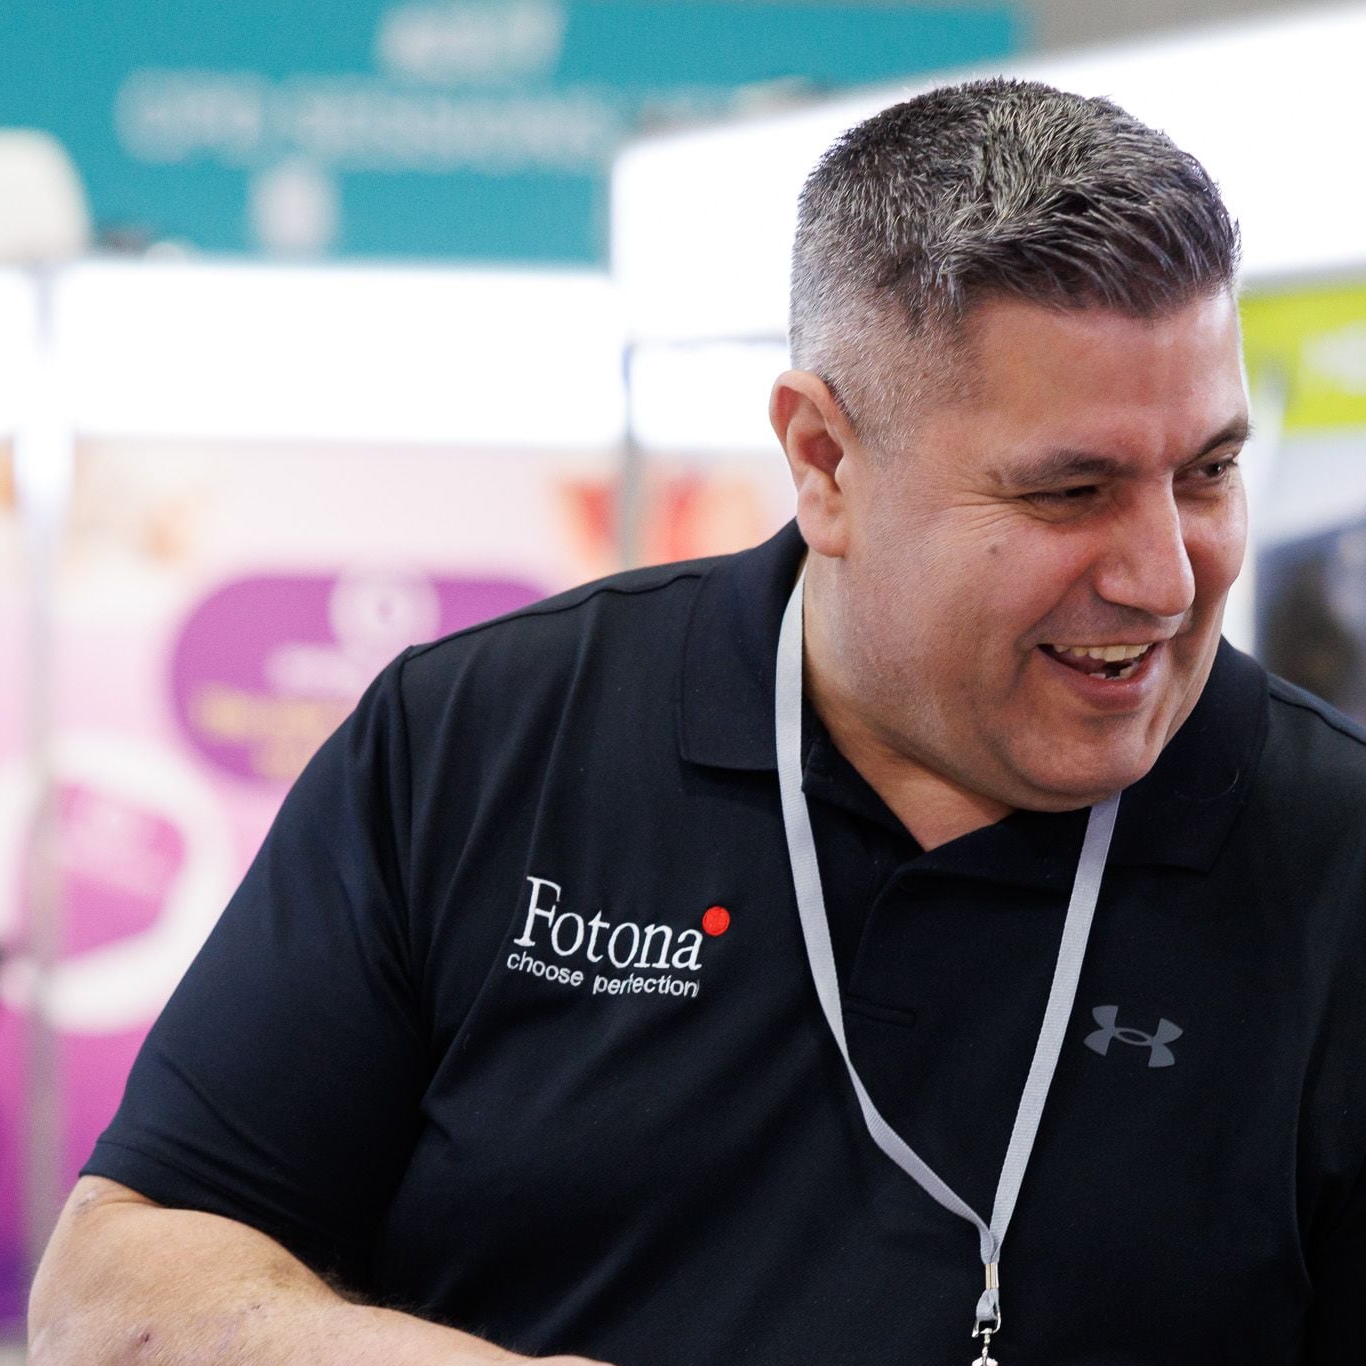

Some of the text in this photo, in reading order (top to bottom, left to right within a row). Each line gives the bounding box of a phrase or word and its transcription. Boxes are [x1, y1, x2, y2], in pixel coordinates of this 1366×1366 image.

[513, 875, 704, 971] Fotona
[506, 951, 700, 998] choose perfection
